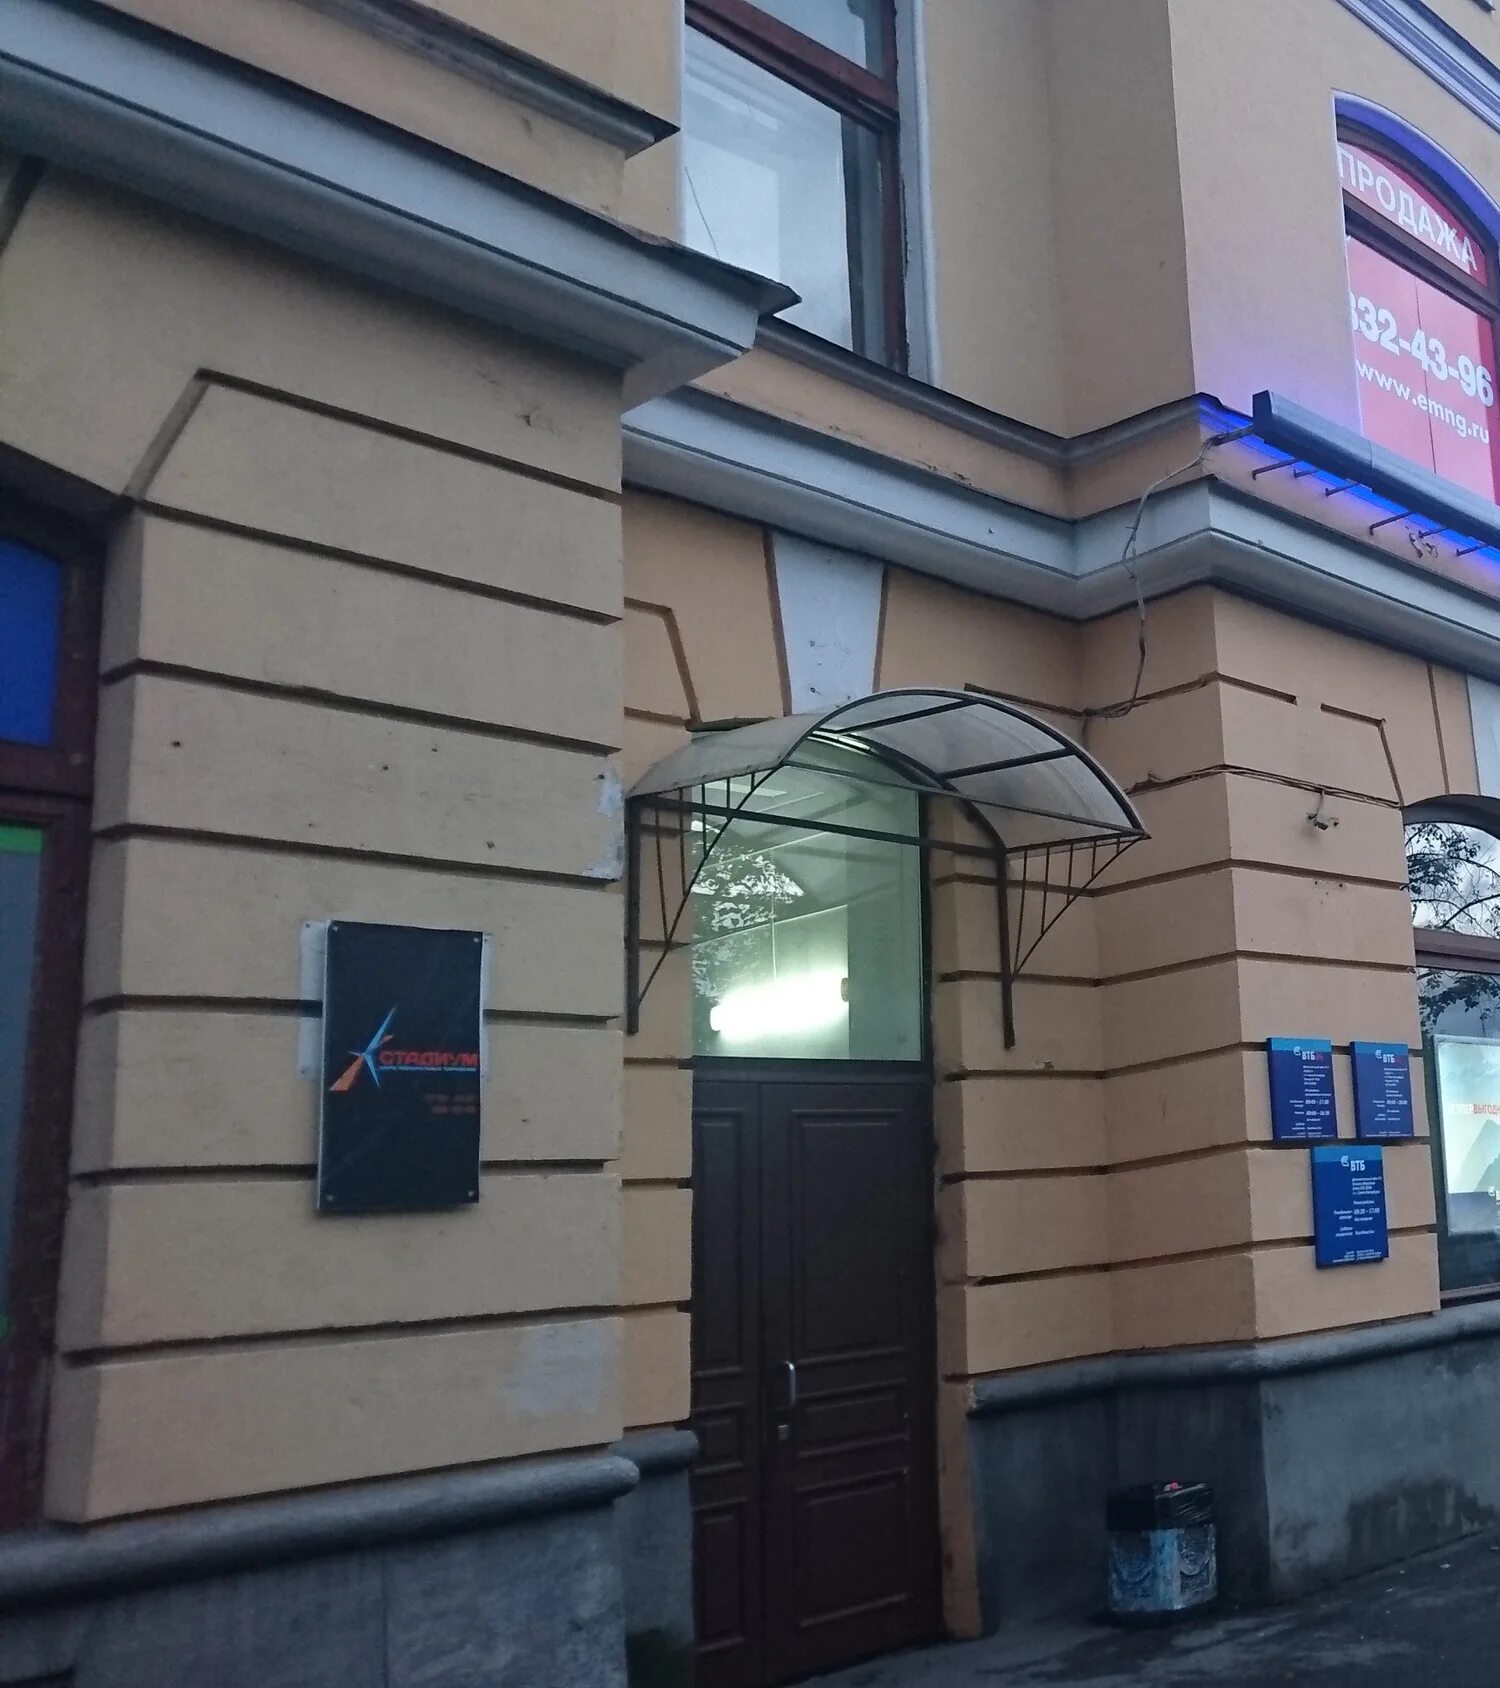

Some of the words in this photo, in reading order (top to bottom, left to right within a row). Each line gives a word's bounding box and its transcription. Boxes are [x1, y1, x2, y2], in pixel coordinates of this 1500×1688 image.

[1338, 146, 1479, 272] ПРОДАЖА
[1355, 358, 1490, 444] www.emng.ru
[379, 1050, 479, 1067] СТАДИУМ
[1350, 1159, 1366, 1172] ВТБ
